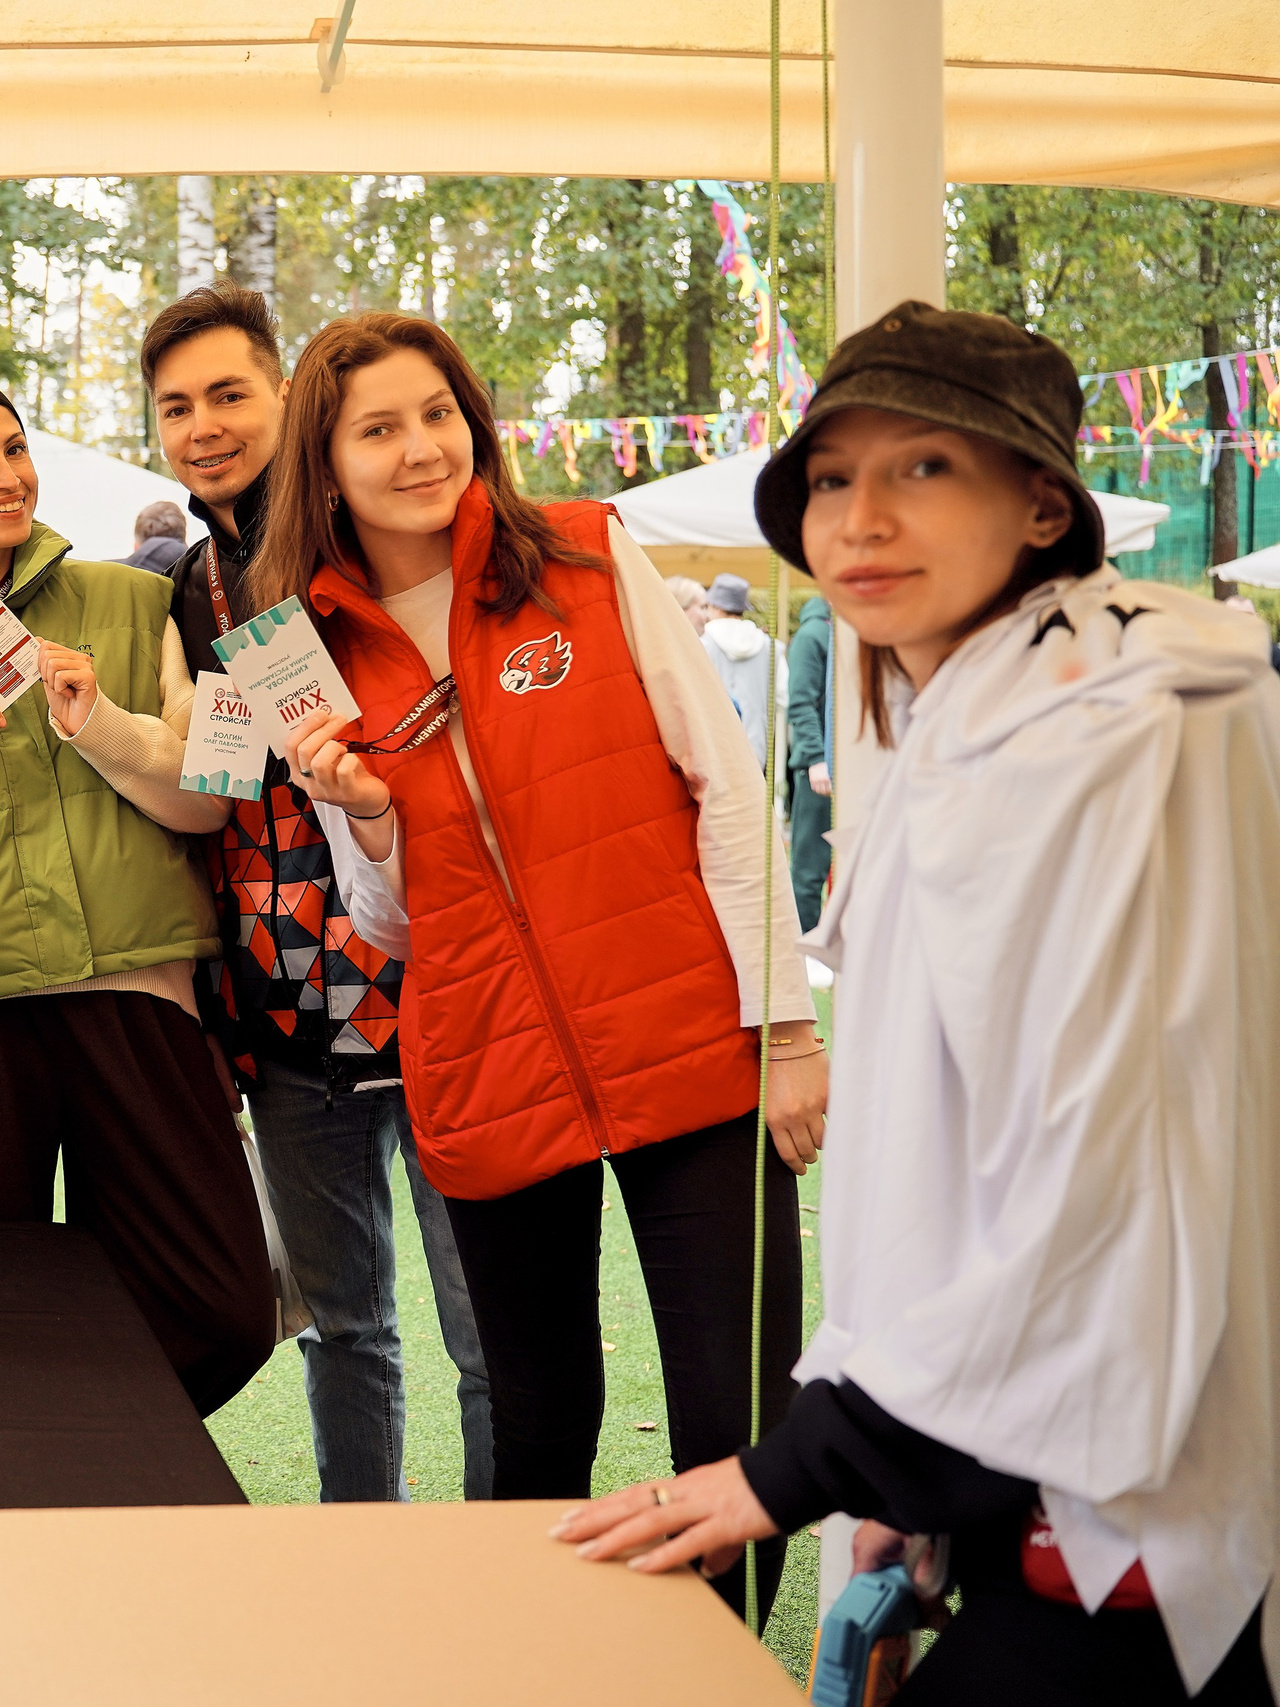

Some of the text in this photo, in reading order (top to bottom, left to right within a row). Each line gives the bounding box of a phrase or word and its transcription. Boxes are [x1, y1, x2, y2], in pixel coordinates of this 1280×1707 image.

[265, 663, 309, 691] КИРИЛОВА
[275, 679, 319, 709] СТРОЙСЛЁТ
[279, 688, 327, 724] XVIII
[209, 714, 251, 726] СТРОЙСЛЁТ
[213, 731, 243, 741] ВОЛГИН
